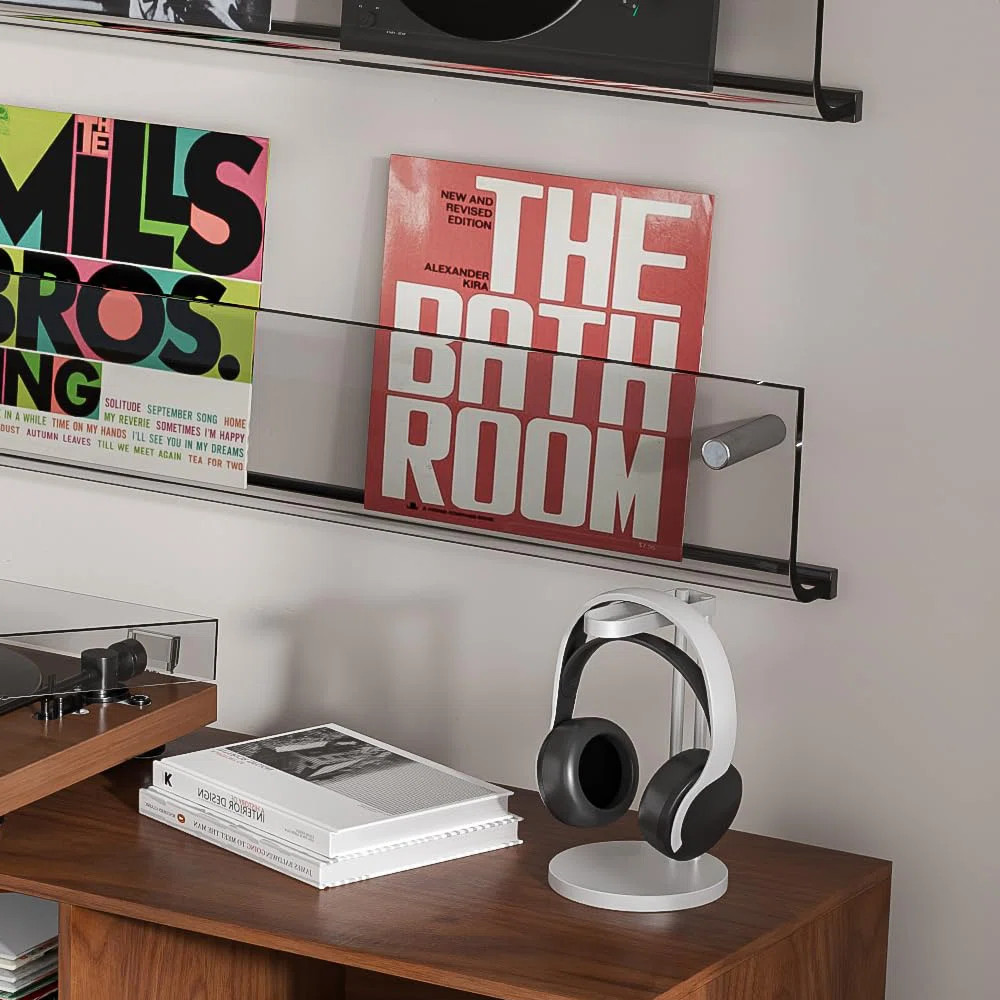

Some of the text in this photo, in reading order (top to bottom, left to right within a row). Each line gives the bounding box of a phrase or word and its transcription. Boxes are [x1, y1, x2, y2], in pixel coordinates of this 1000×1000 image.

[441, 190, 494, 206] NEW AND
[446, 202, 493, 218] REVISED
[448, 216, 492, 230] EDITION
[475, 175, 692, 318] THE
[424, 262, 490, 281] ALEXANDER
[462, 278, 489, 292] KIRA
[387, 281, 680, 433] BATH
[104, 412, 245, 444] MY REVERIE SOMETIMES I'M HAPPY
[105, 398, 246, 429] SOLITUDE SEPTEMBER SONG HOME
[4, 410, 12, 421] IN
[15, 412, 20, 422] A
[22, 412, 47, 426] WHILE
[52, 418, 71, 430] TIME
[73, 420, 84, 431] ON
[86, 422, 98, 434] MY
[100, 426, 126, 438] HANDS
[132, 430, 146, 442] I'LL
[149, 433, 164, 444] SEE
[166, 436, 182, 448] YOU
[184, 439, 194, 449] IN
[196, 440, 208, 452] MY
[211, 444, 244, 458] DREAMS
[26, 428, 59, 441] AUTUMN
[62, 433, 92, 446] LEAVES
[98, 438, 114, 450] TILL
[117, 442, 130, 453] WE
[134, 445, 155, 457] MEET
[158, 448, 182, 461] AGAIN
[188, 454, 203, 464] TEA
[207, 456, 223, 468] FOR
[226, 459, 244, 471] TWO
[381, 394, 666, 542] ROOM
[164, 771, 172, 787] K
